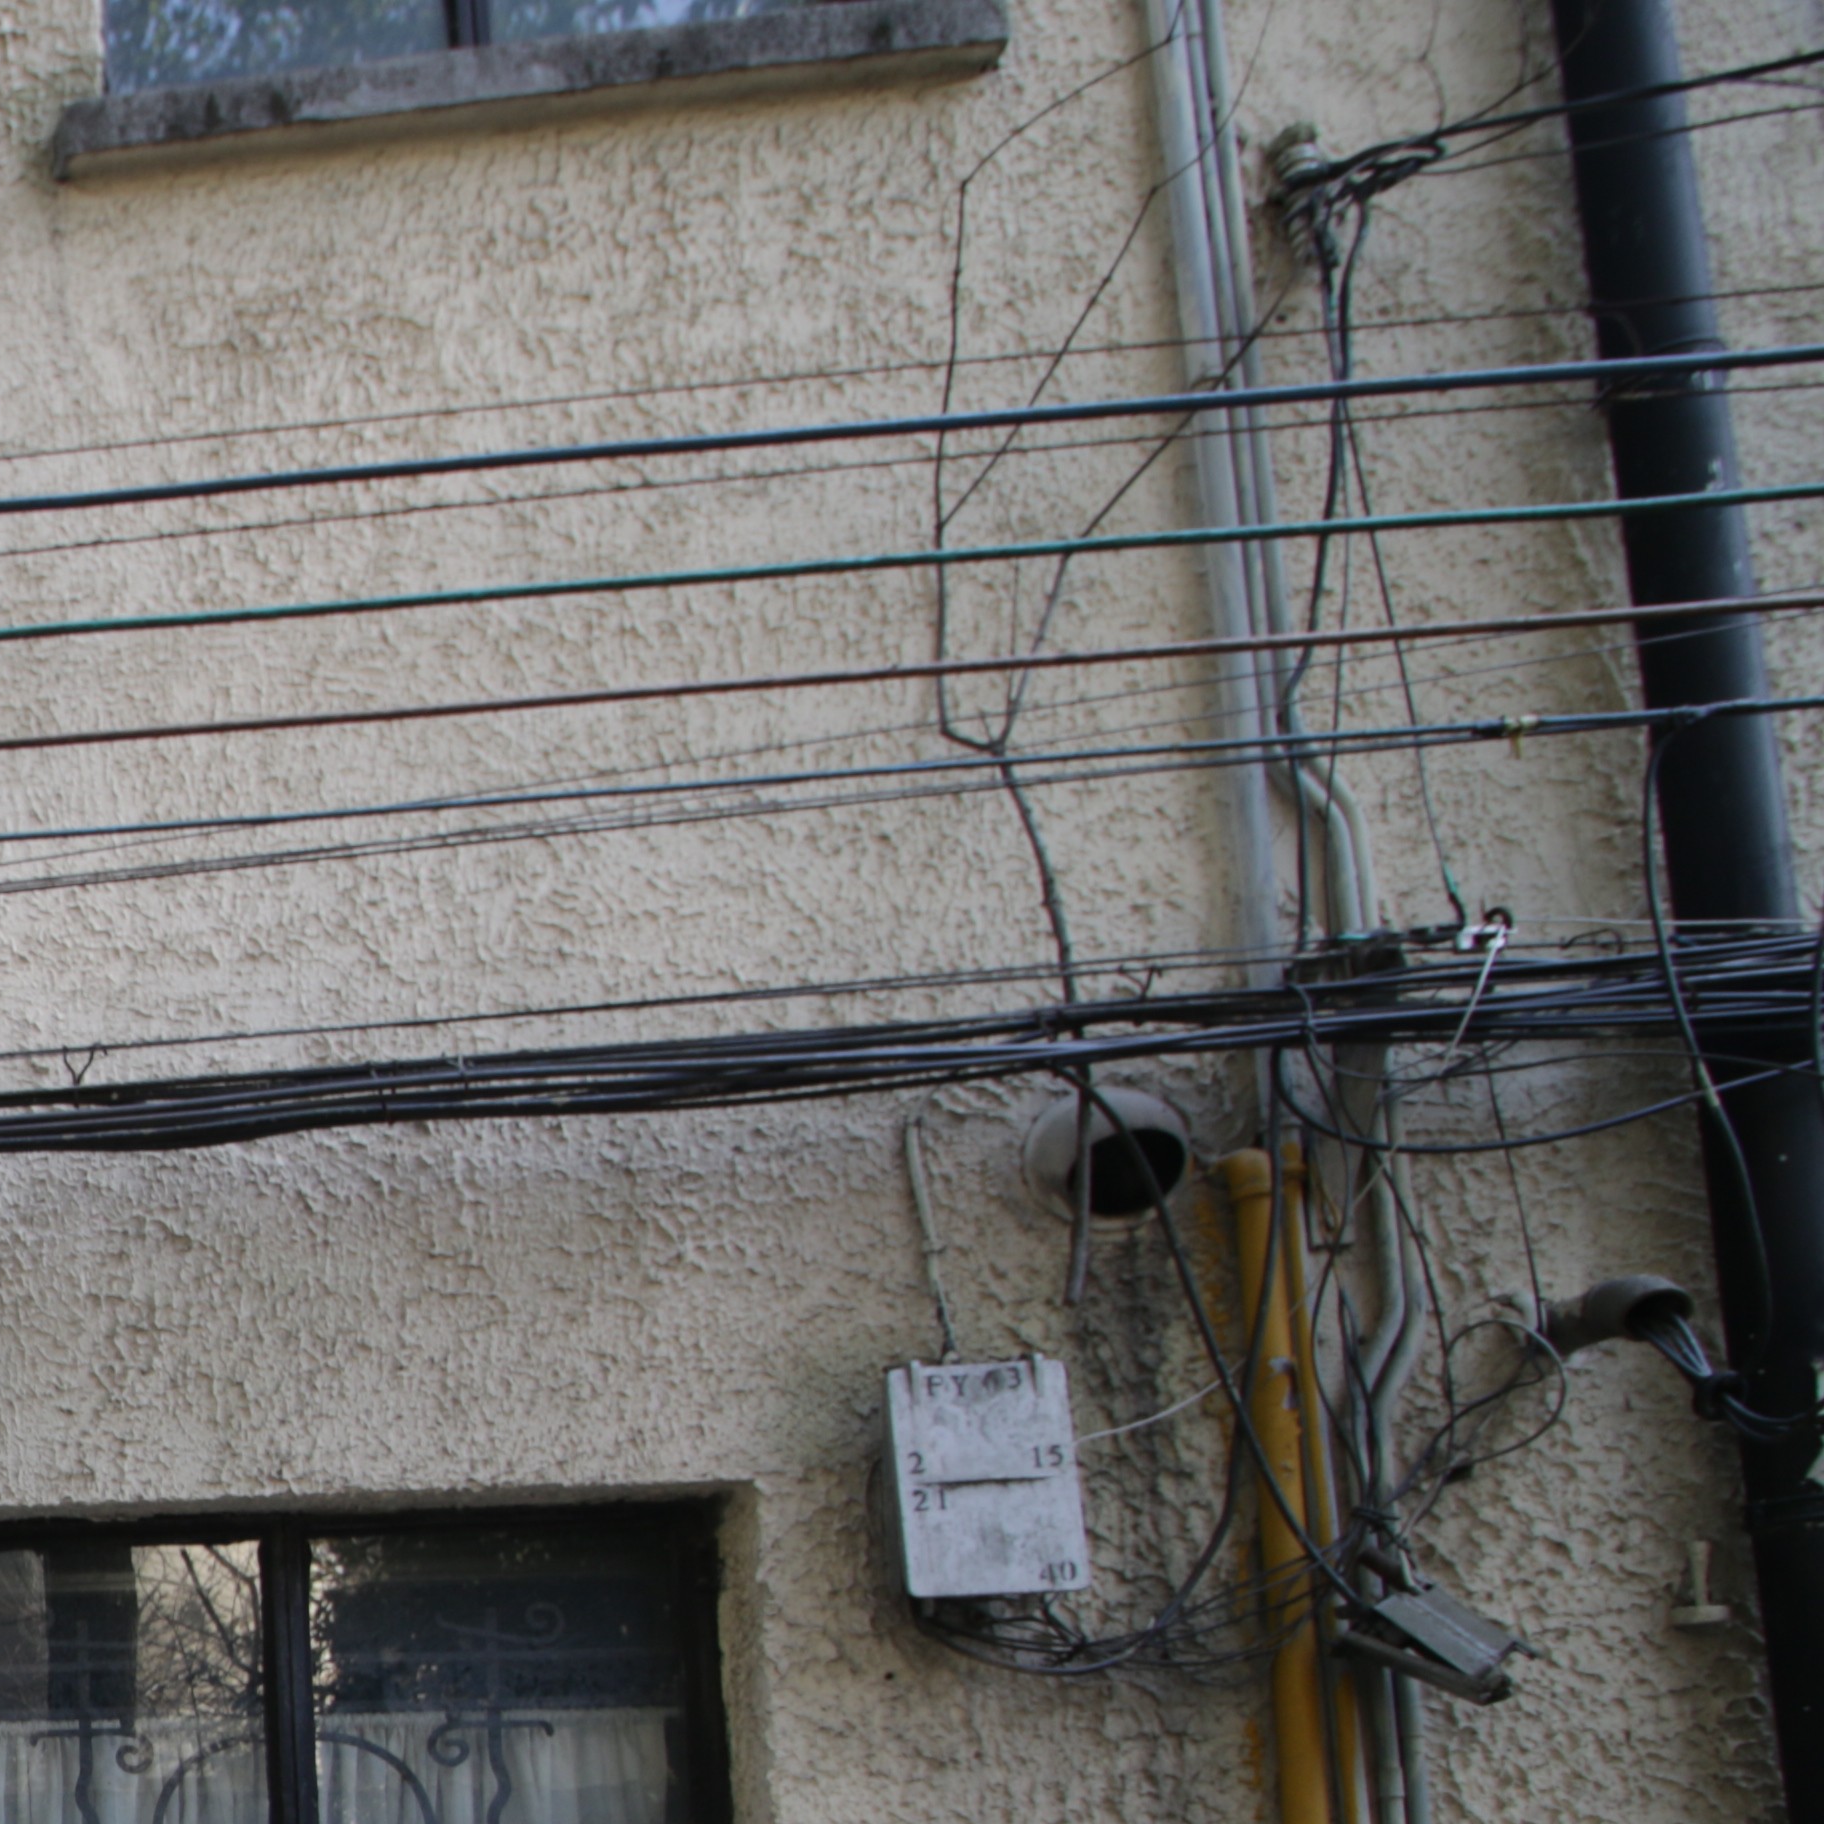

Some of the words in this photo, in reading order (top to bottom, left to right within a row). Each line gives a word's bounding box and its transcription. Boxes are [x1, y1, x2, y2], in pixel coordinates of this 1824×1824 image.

[1032, 1444, 1064, 1469] 15
[912, 1488, 948, 1512] 21
[1039, 1561, 1078, 1584] 40
